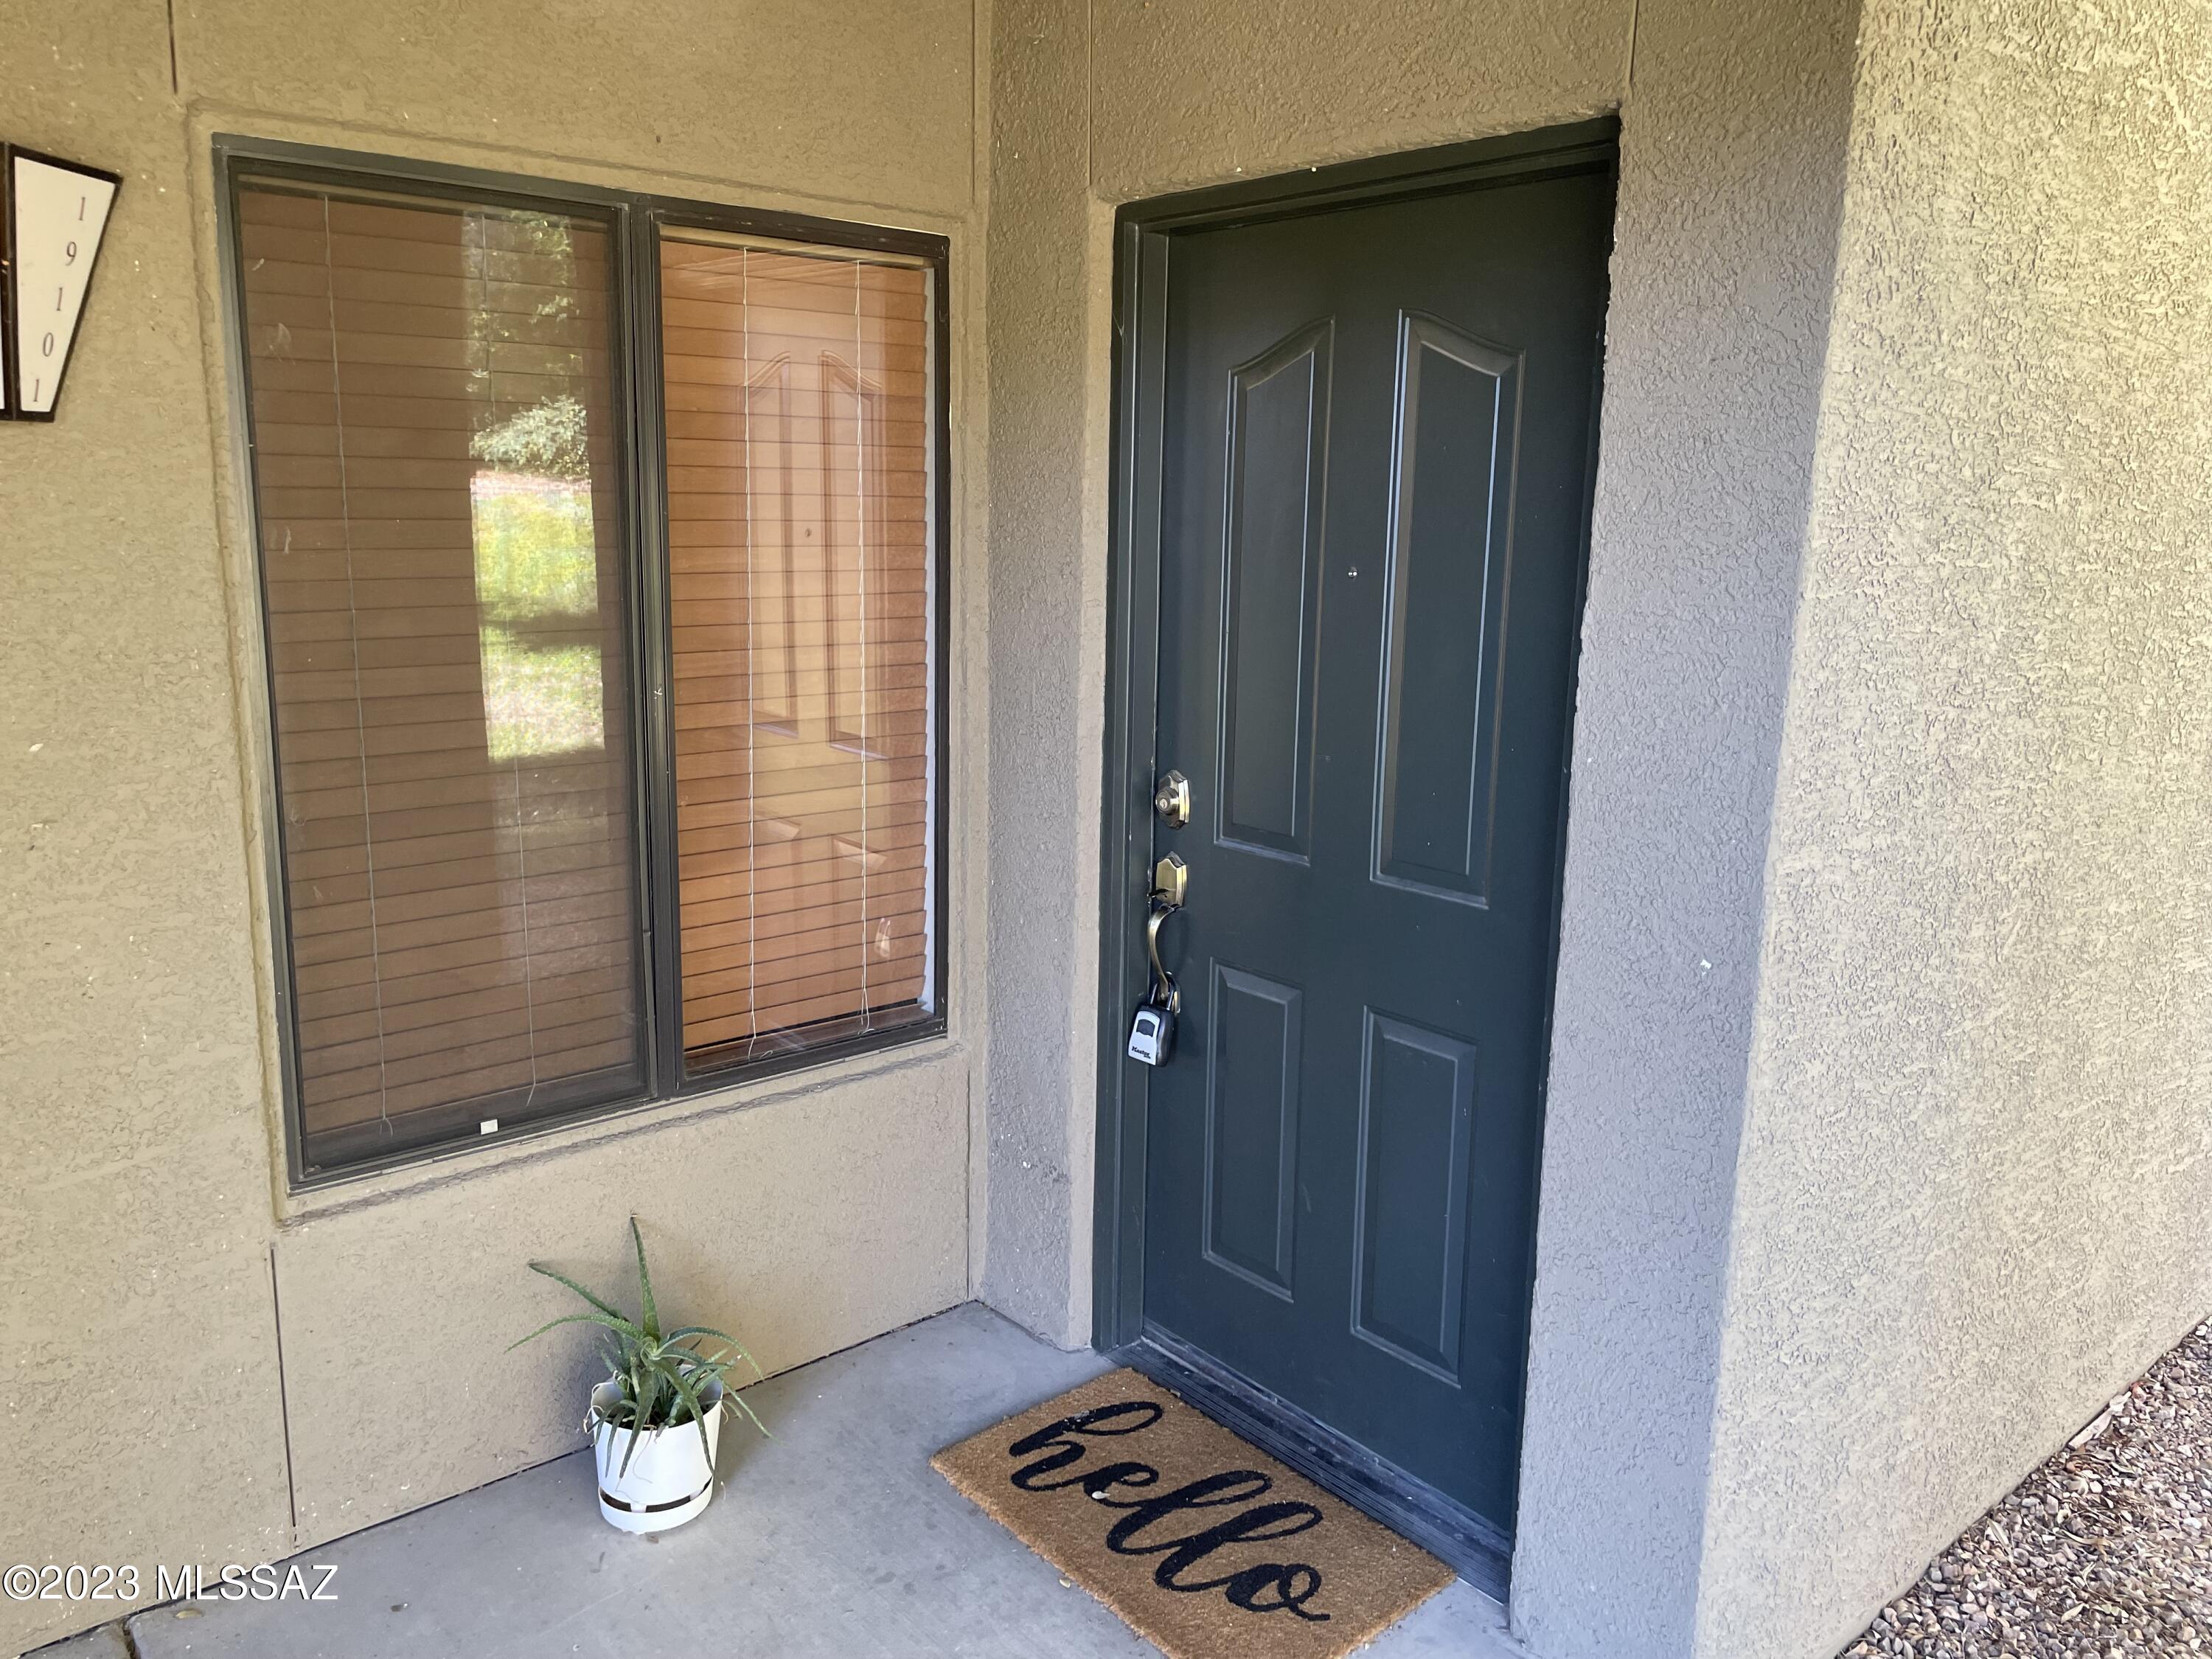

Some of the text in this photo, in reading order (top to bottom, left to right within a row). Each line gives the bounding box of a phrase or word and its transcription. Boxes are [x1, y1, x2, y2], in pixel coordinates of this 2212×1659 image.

[32, 196, 86, 403] 19101
[1131, 1046, 1150, 1057] Master
[1009, 1401, 1330, 1621] hello
